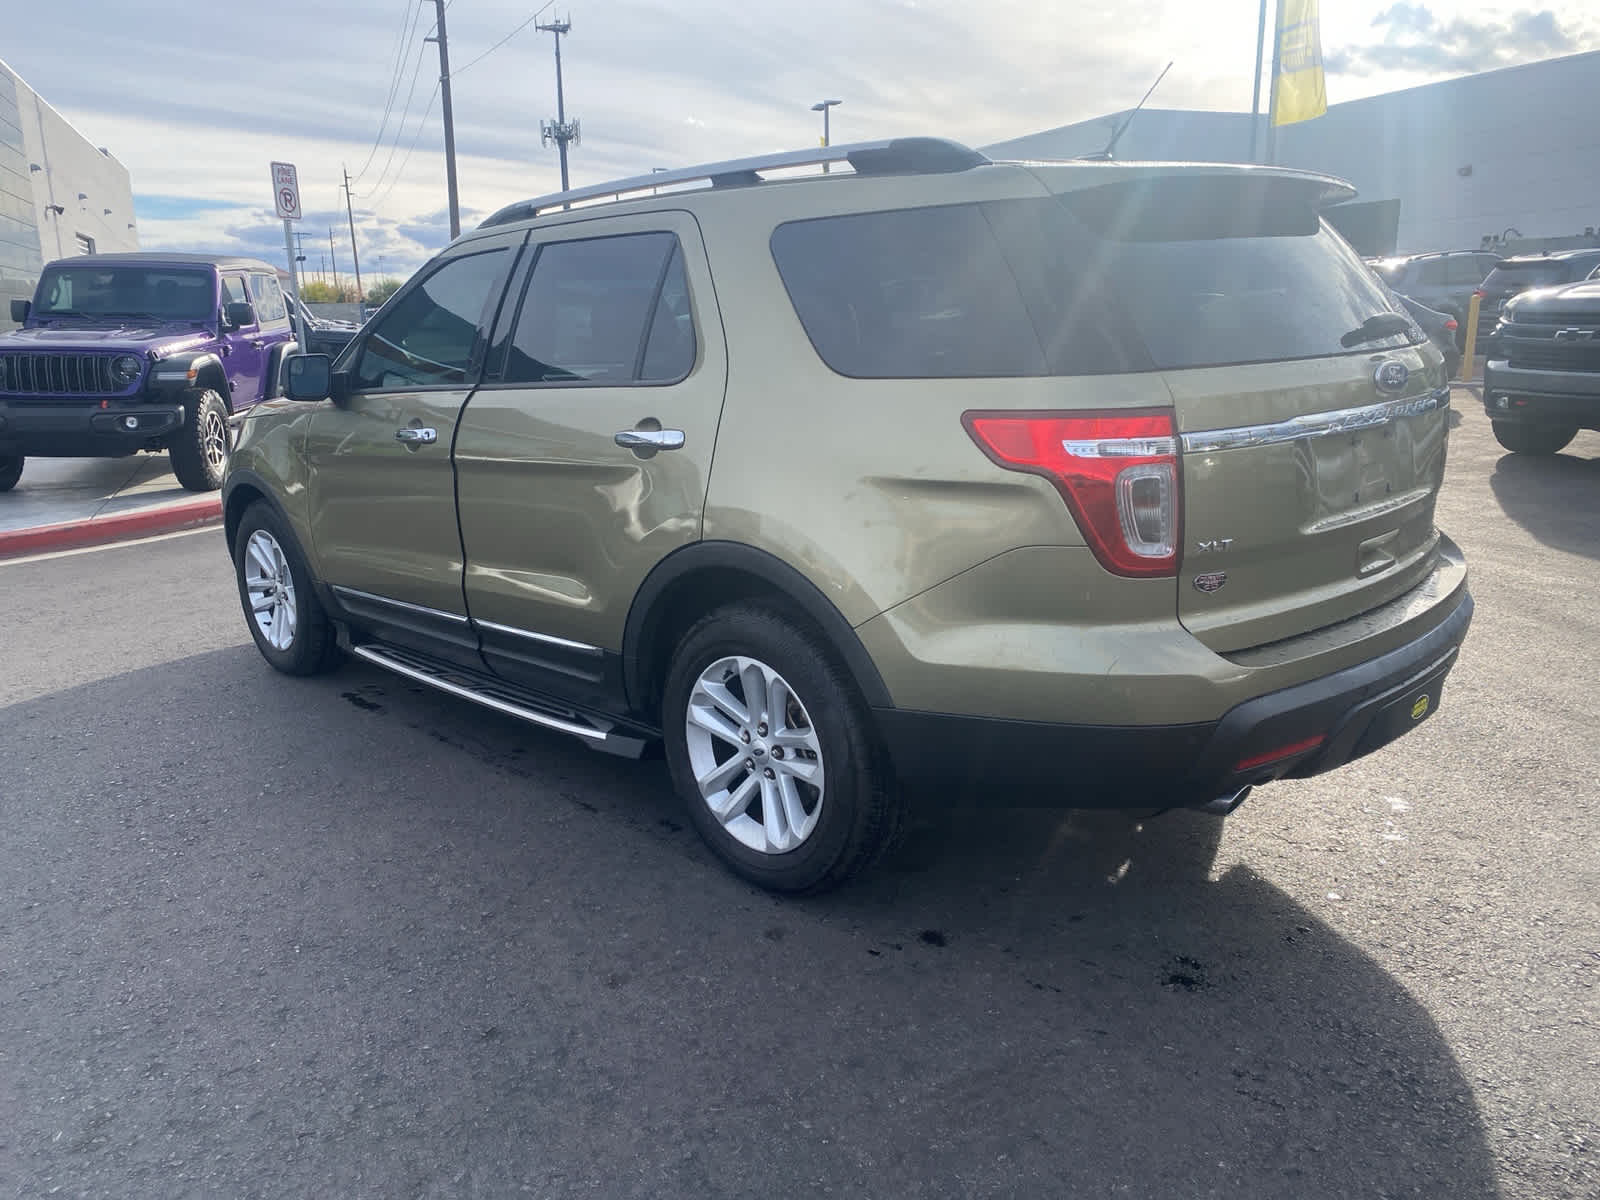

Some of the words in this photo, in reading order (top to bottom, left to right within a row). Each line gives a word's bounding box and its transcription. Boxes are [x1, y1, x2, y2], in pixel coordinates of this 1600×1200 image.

[277, 167, 294, 177] FIRE
[277, 176, 295, 185] LANE
[1343, 398, 1438, 427] EXPLORER
[1197, 538, 1233, 552] XLT
